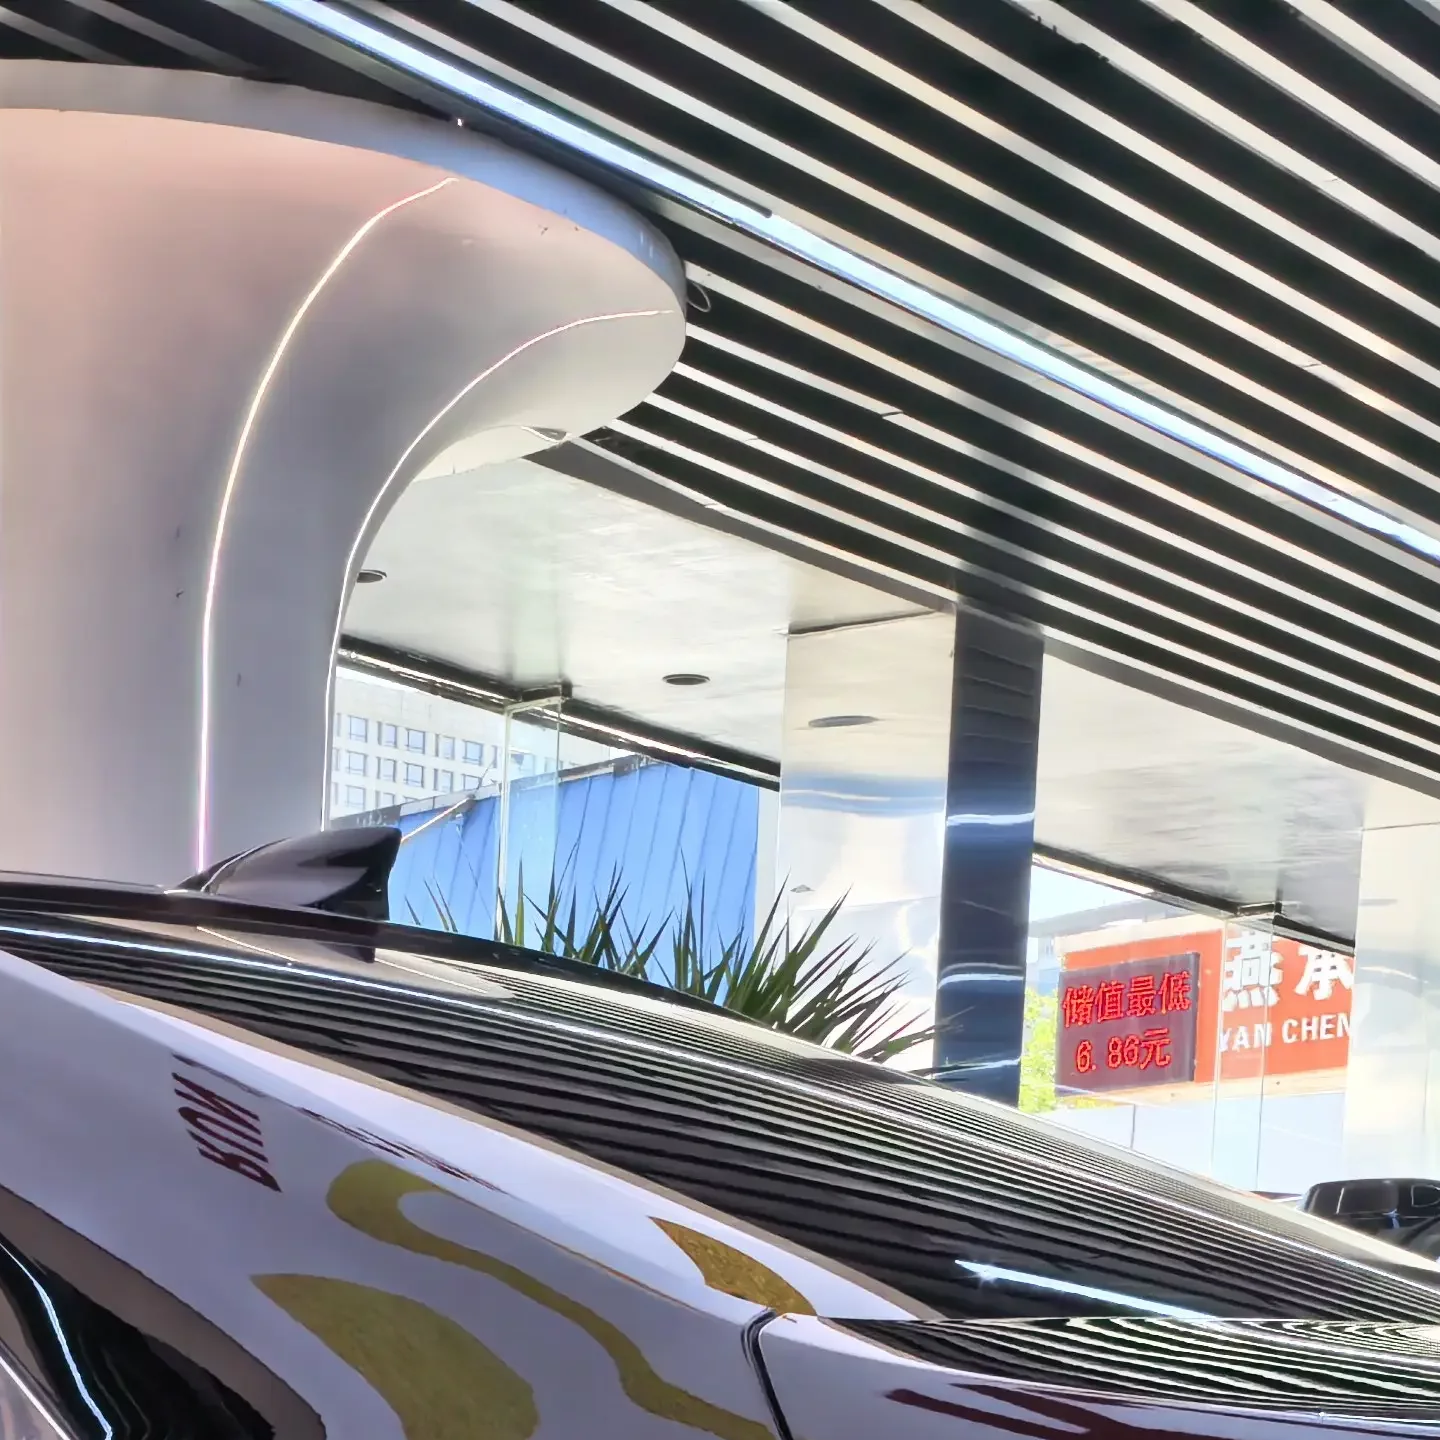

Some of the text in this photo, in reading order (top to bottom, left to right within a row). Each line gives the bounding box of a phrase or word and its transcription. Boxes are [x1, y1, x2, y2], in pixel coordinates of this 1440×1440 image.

[1062, 969, 1192, 1028] 储值最低
[1281, 1012, 1351, 1044] CHEN
